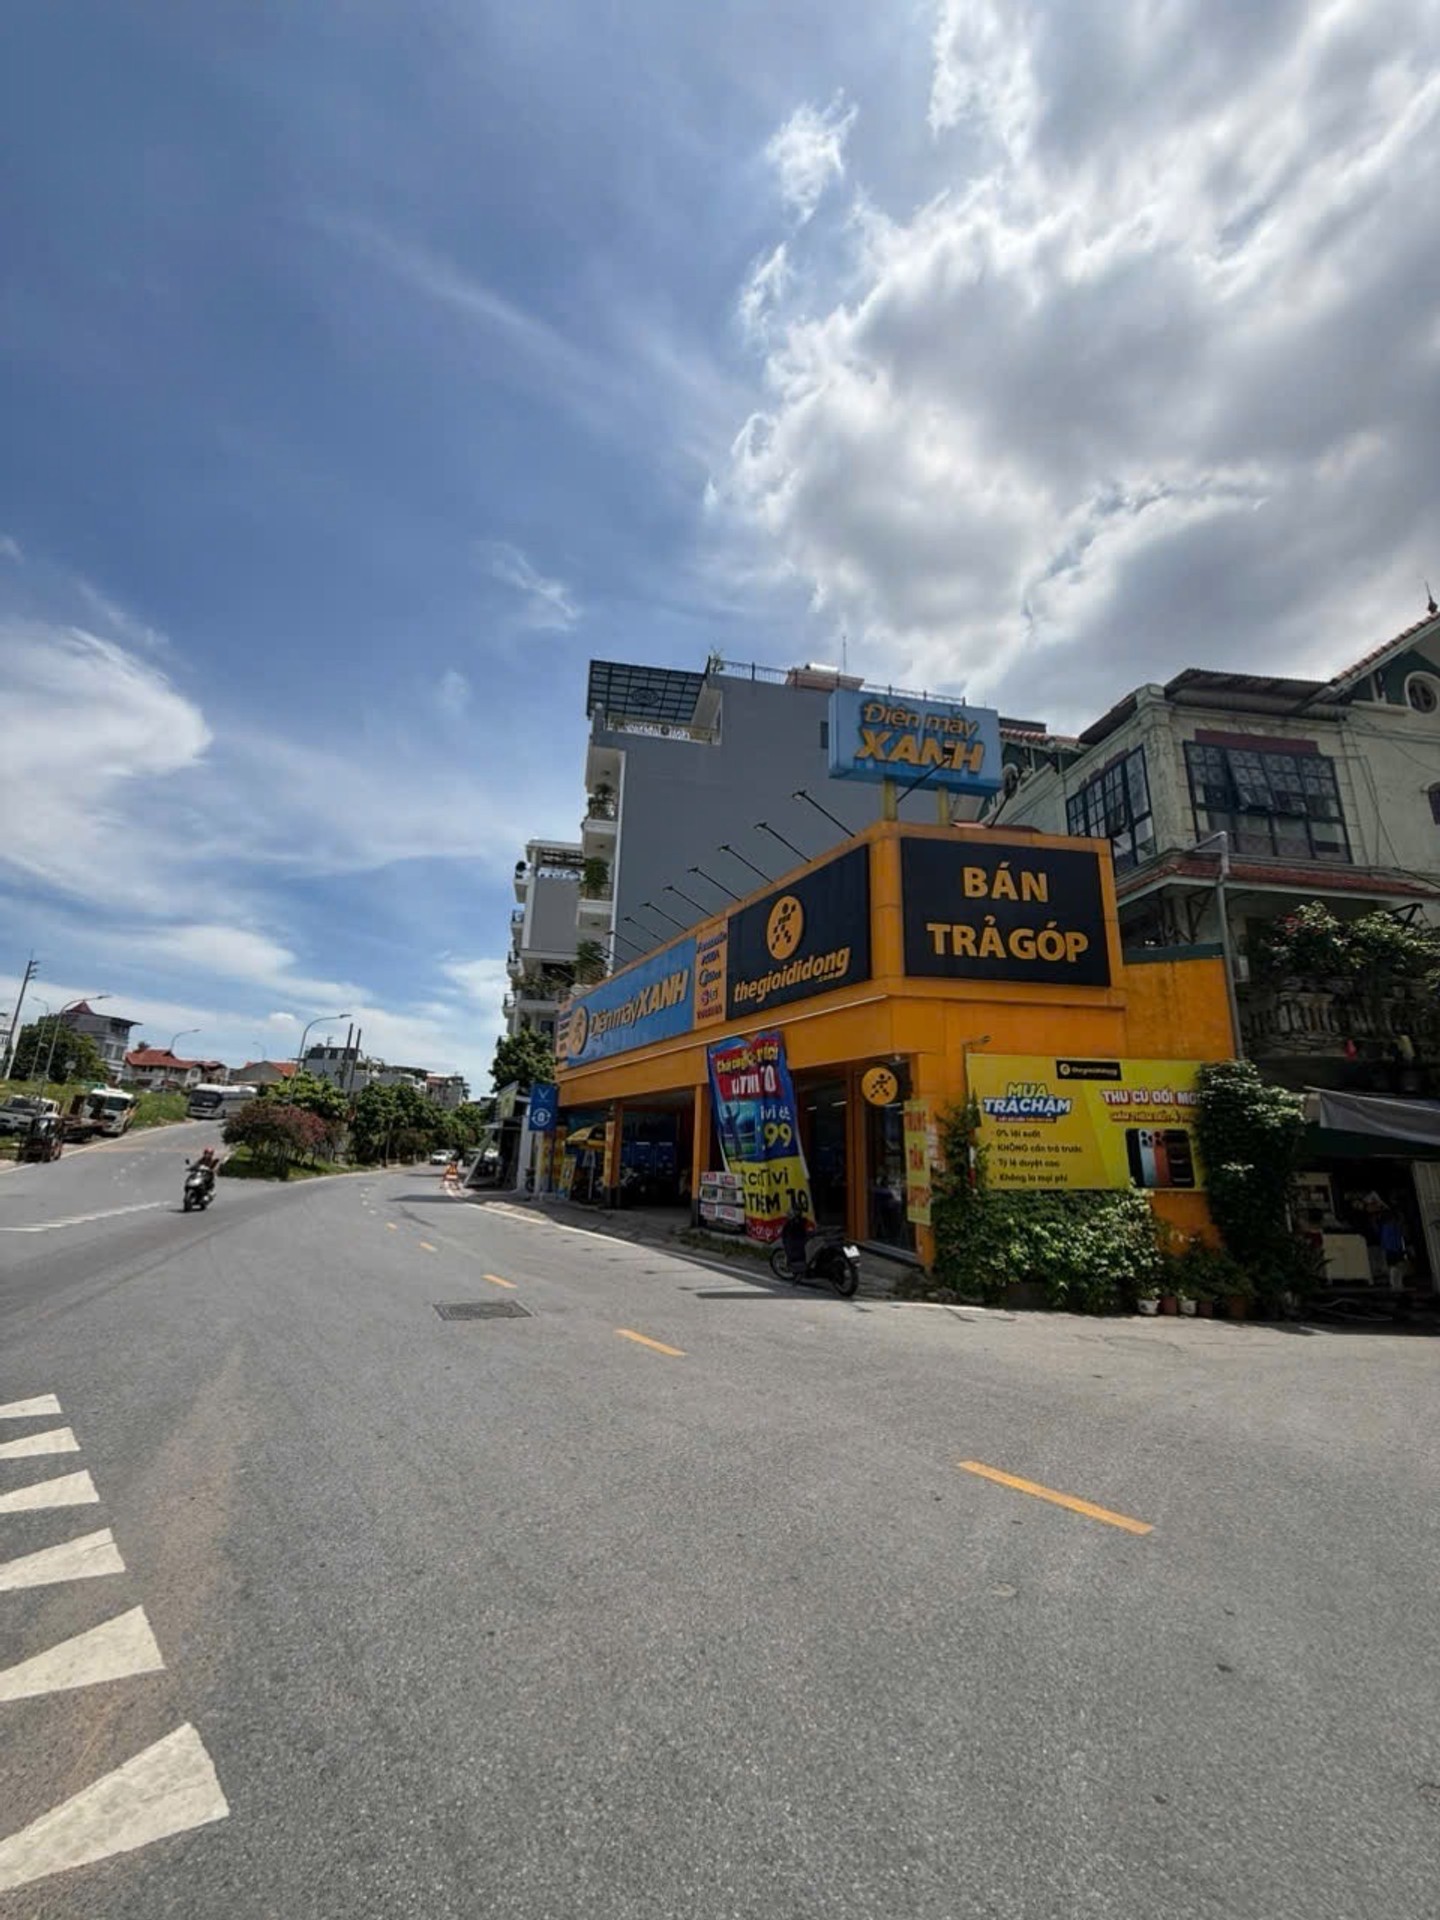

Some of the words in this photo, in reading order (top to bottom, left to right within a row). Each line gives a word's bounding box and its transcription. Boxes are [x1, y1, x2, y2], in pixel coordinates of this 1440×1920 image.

[864, 702, 920, 728] Điện
[926, 713, 978, 739] máy
[855, 729, 985, 772] XANH
[962, 861, 1049, 903] BÁN
[733, 946, 852, 1003] thegioididong
[1007, 1082, 1048, 1098] MUA
[1103, 1089, 1129, 1104] THU
[997, 1143, 1028, 1152] KHÔNG
[999, 1173, 1026, 1183] Không
